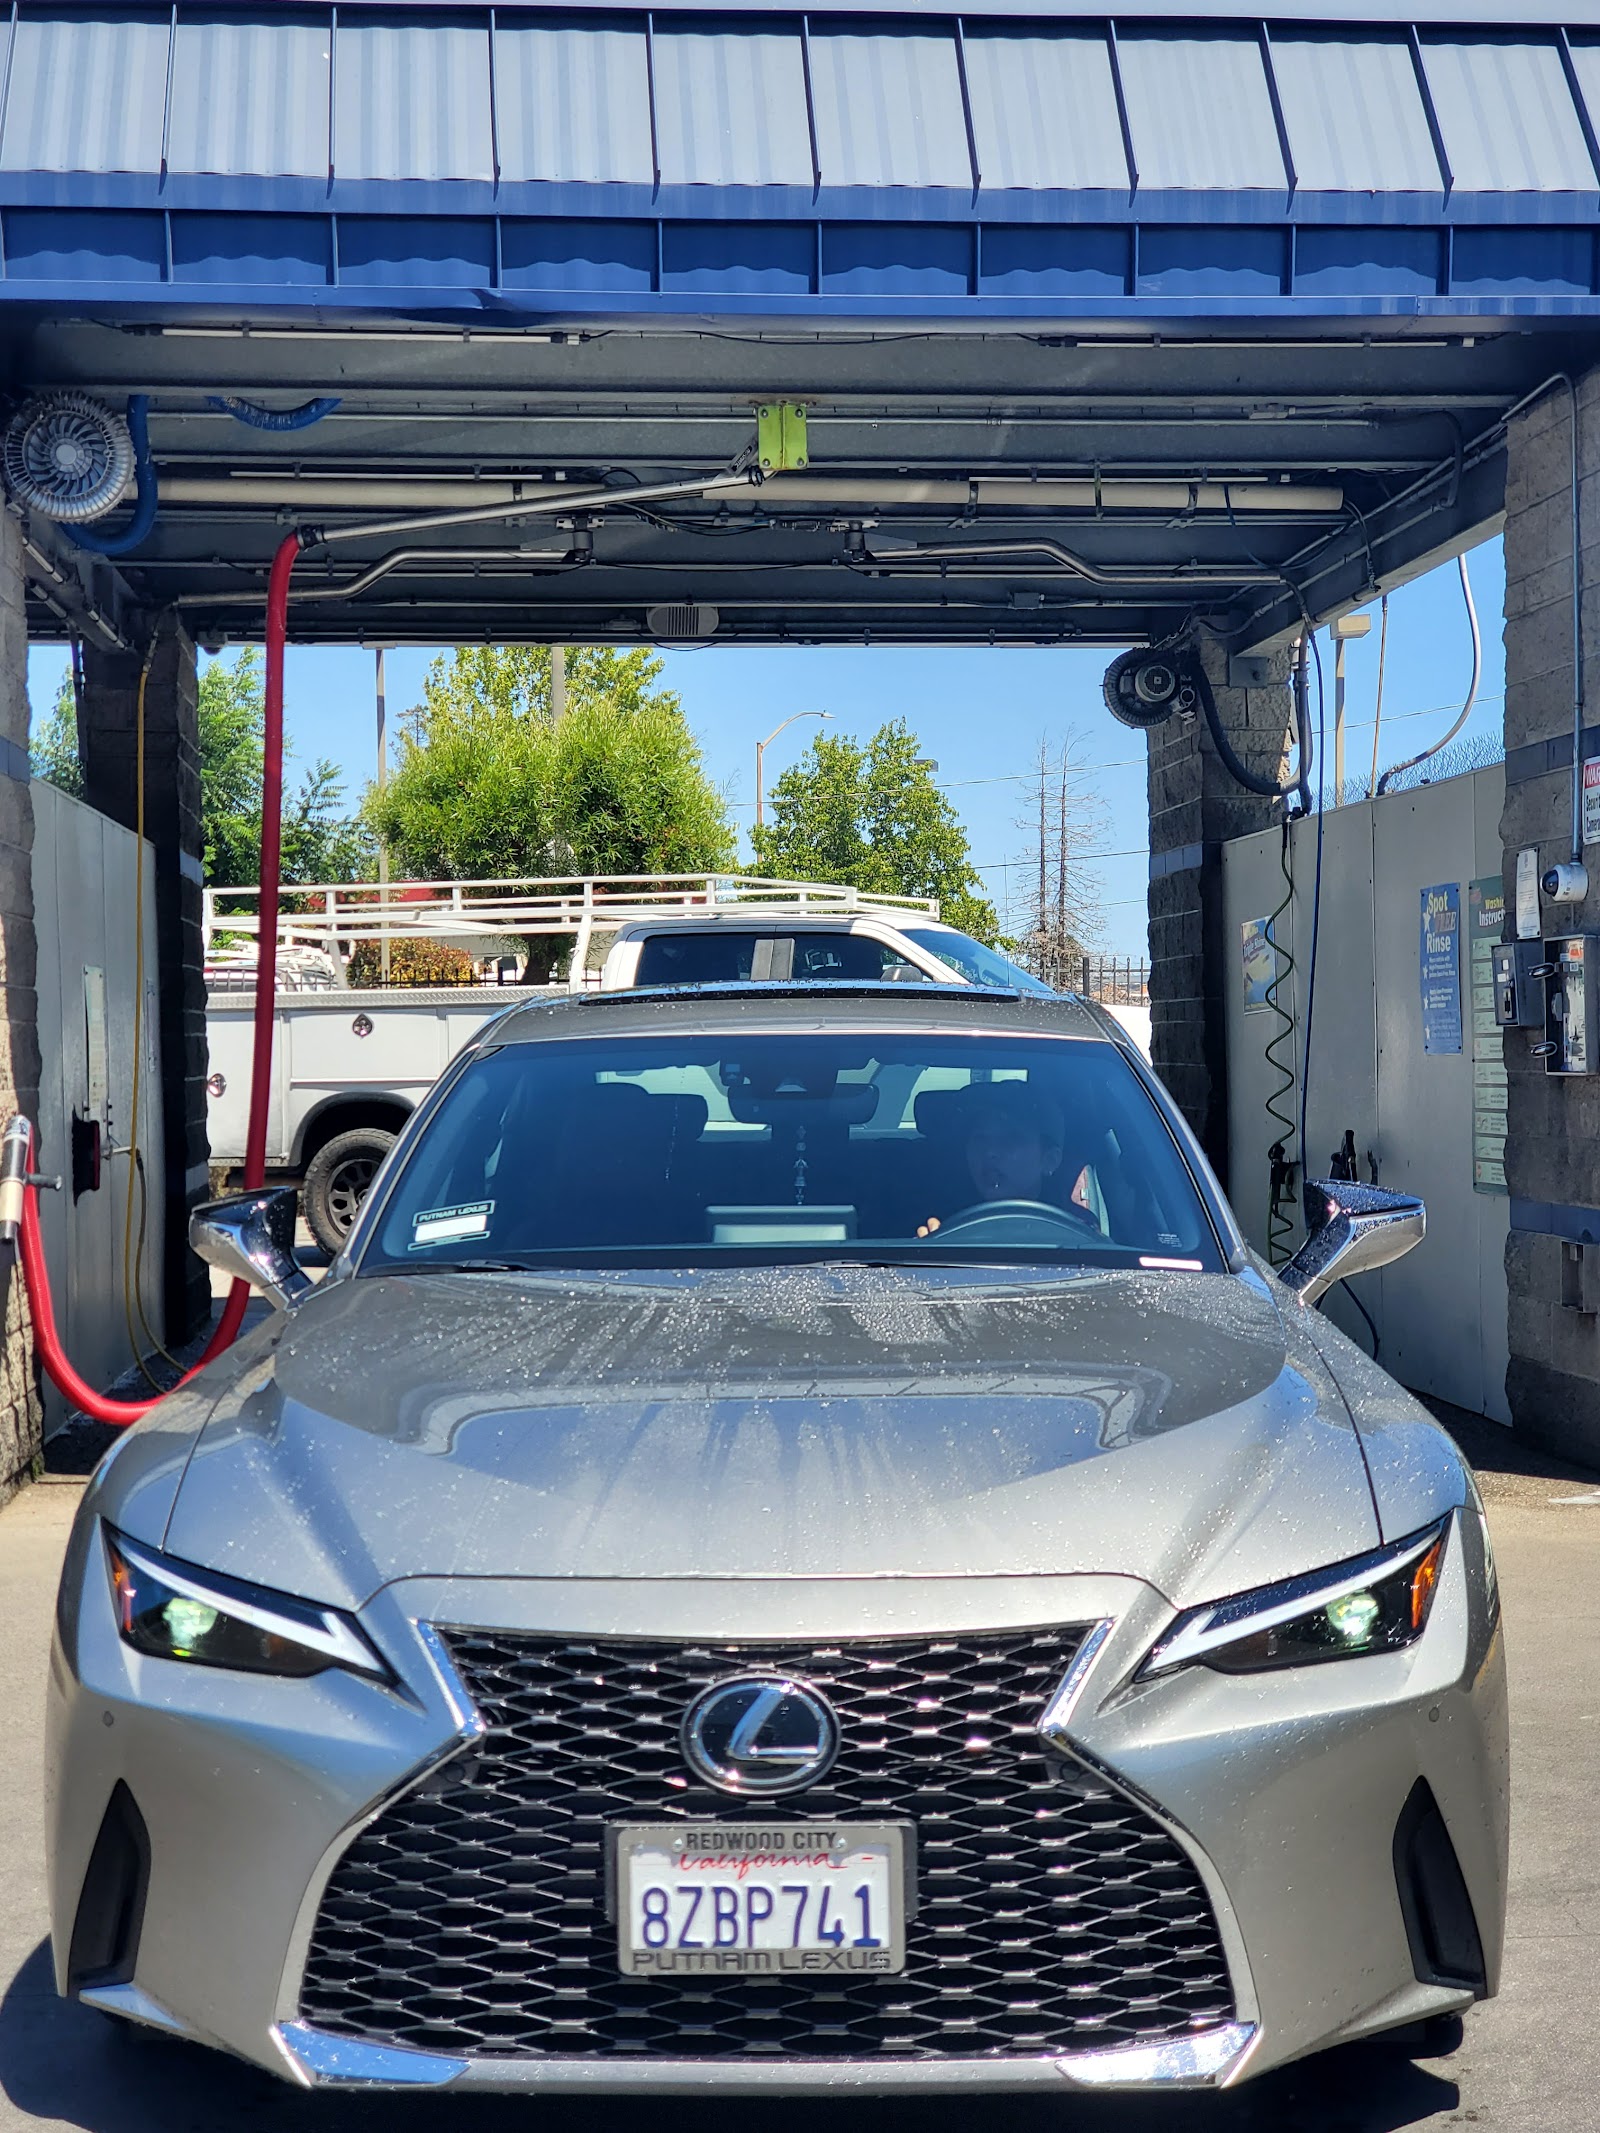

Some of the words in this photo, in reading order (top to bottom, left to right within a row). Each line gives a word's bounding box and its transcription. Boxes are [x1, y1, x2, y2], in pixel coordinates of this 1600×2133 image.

[1428, 891, 1448, 918] Spot
[1426, 932, 1451, 953] Rinse
[419, 1209, 456, 1222] PUTNAM
[458, 1204, 488, 1215] LEXUS
[686, 1832, 786, 1850] REDWOOD
[792, 1831, 838, 1850] CITY
[641, 1884, 881, 1948] 8ZBP741
[632, 1952, 771, 1971] PUTNAM
[779, 1952, 892, 1971] LEXUS
